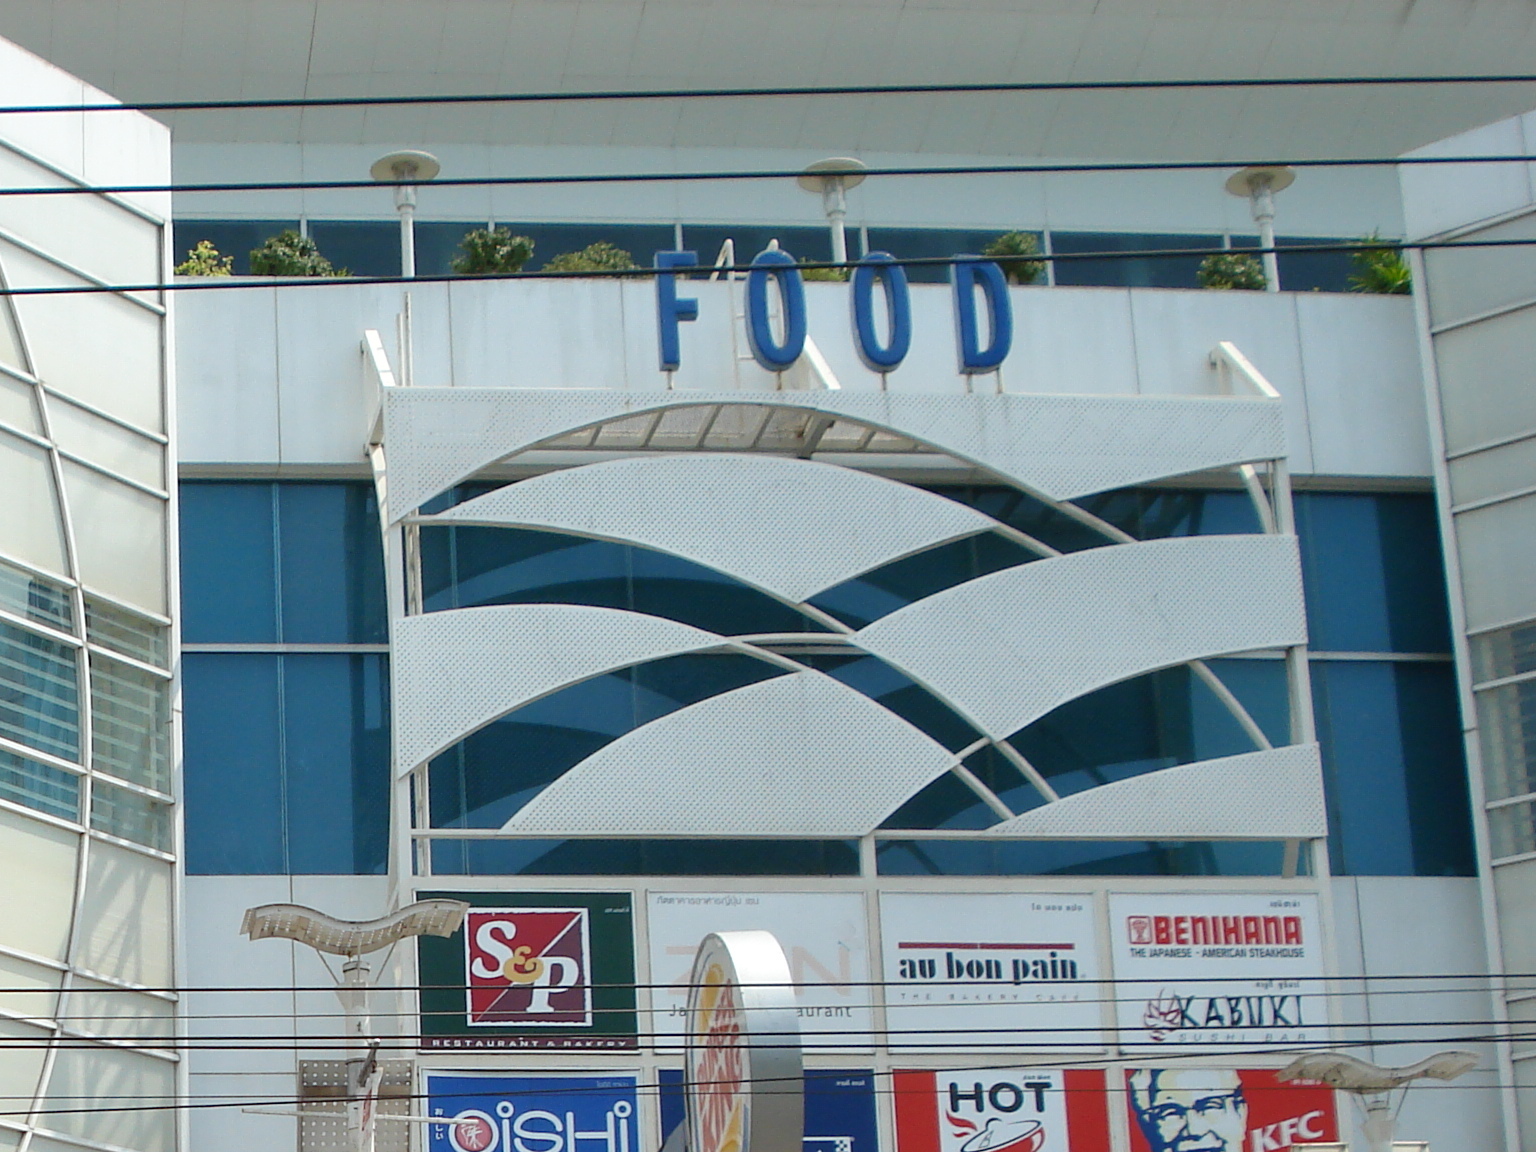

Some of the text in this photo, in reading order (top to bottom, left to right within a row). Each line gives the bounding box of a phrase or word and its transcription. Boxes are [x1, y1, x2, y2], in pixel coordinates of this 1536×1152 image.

[653, 250, 1014, 374] FOOD
[1154, 915, 1304, 946] BENIHANA
[471, 920, 580, 1013] S&P
[899, 951, 1078, 986] au bon pain
[1149, 947, 1193, 958] JAPANESE
[1201, 947, 1248, 958] AMERICAN
[1249, 947, 1305, 958] STEAKHOUSE
[1174, 994, 1304, 1027] KABUKI
[949, 1081, 1053, 1113] HOT
